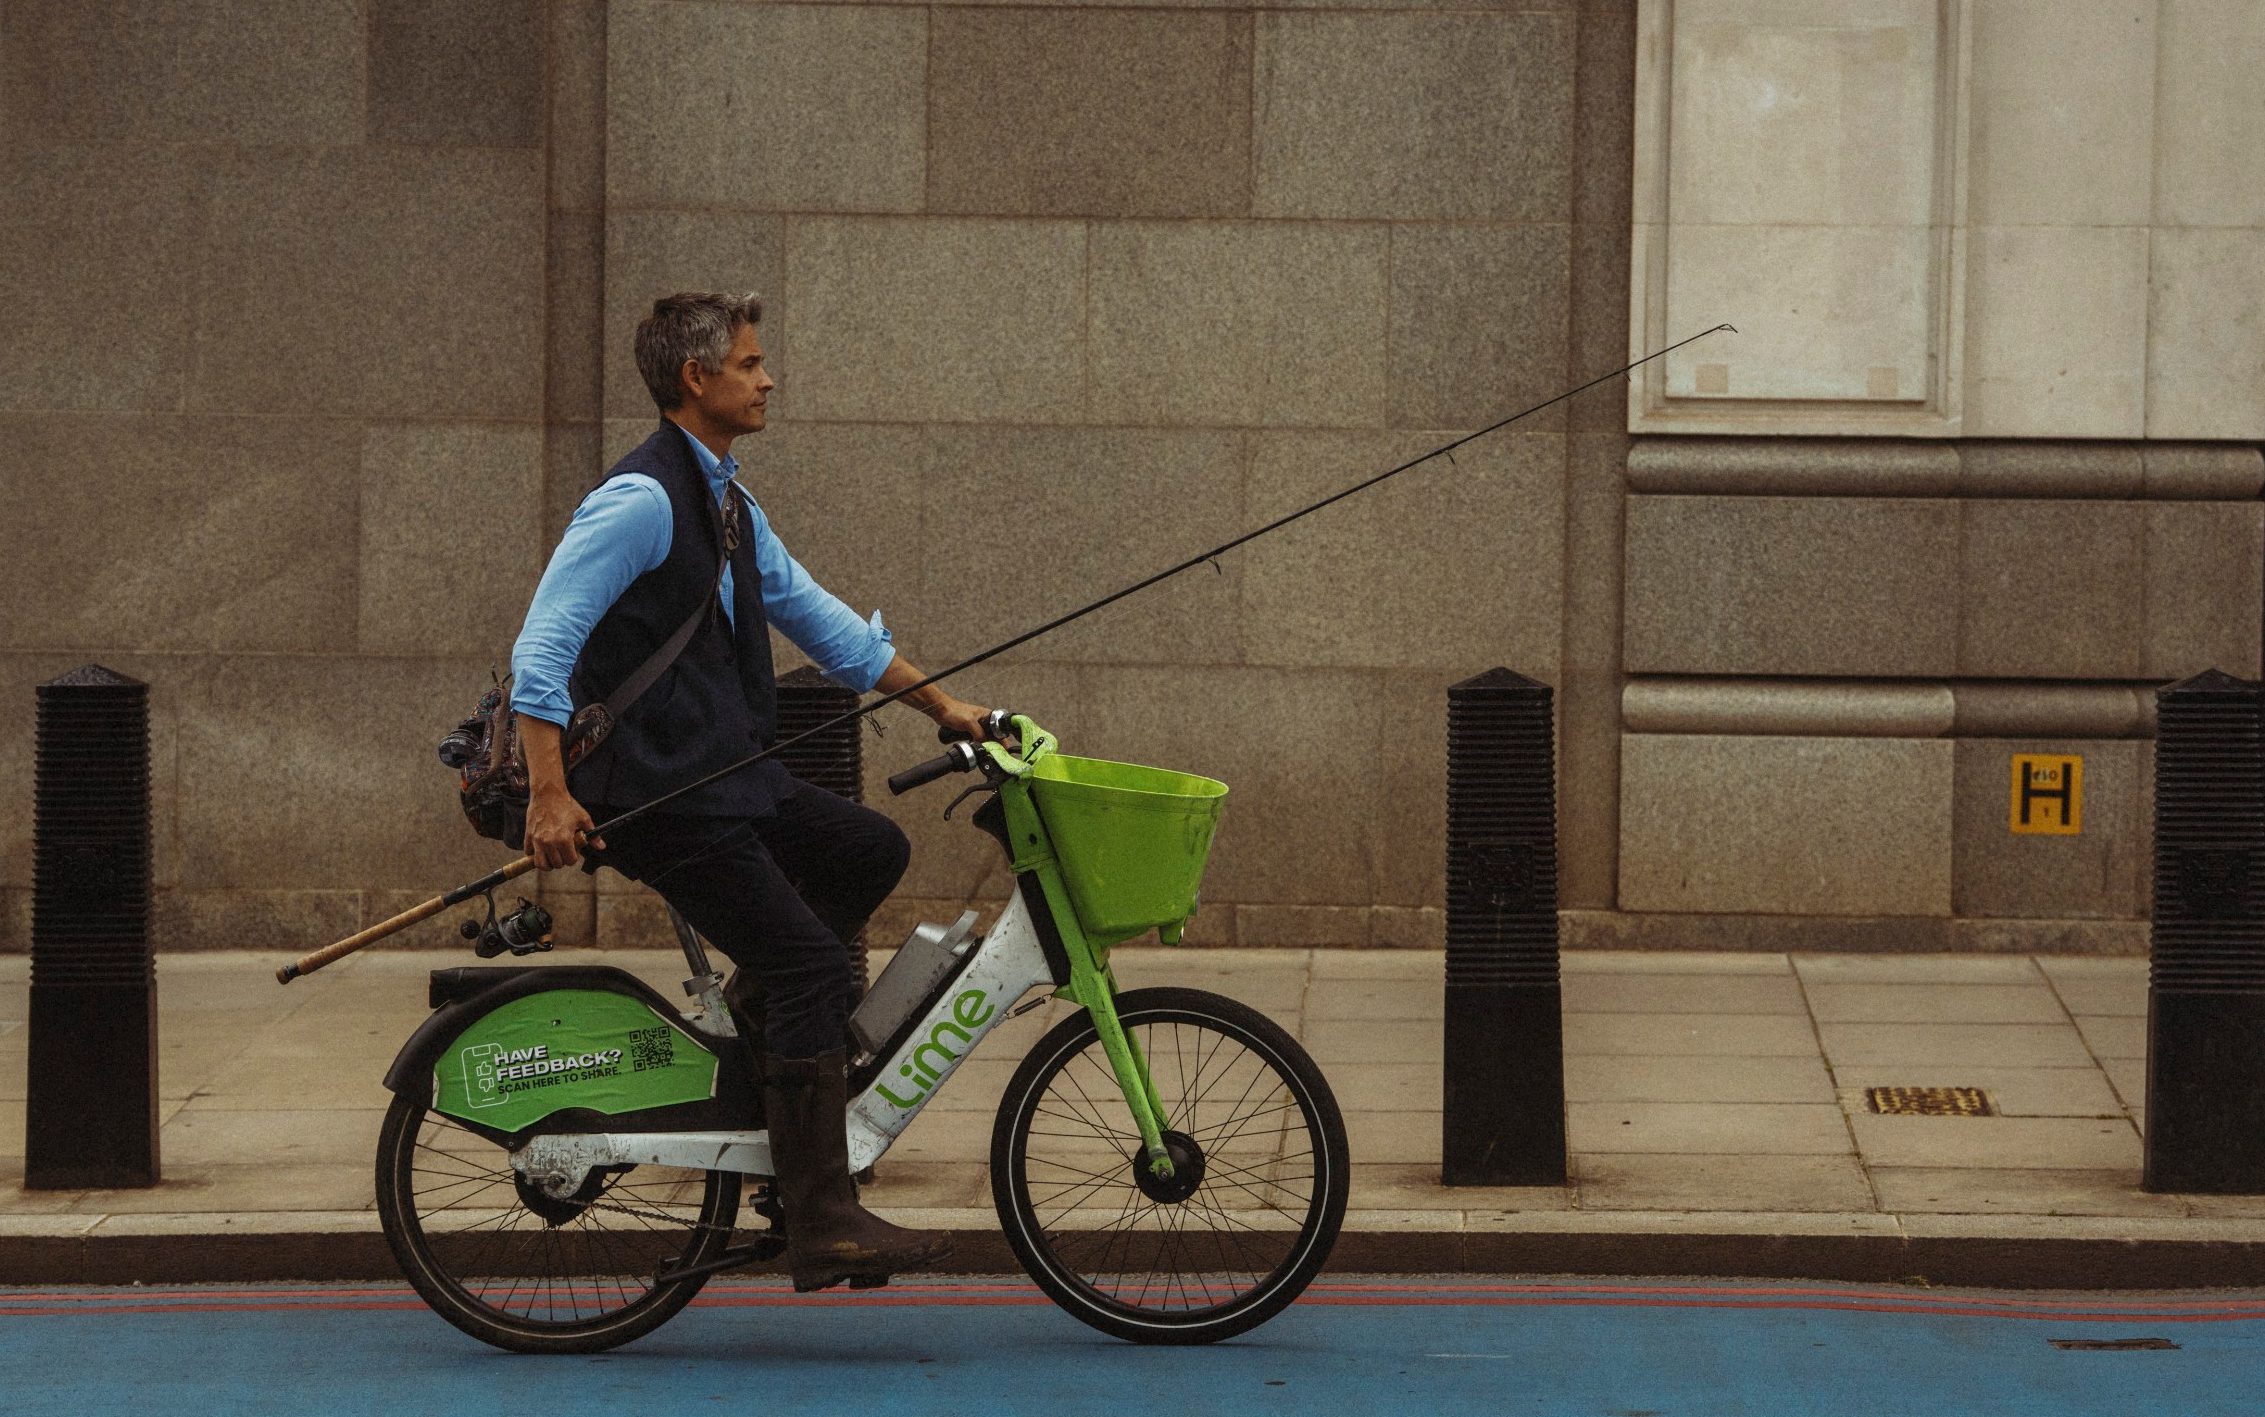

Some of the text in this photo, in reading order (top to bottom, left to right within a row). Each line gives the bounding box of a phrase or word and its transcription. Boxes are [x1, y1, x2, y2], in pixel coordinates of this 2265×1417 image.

[2021, 762, 2072, 826] H
[494, 1045, 548, 1066] HAVE
[875, 989, 995, 1108] Lime
[496, 1049, 623, 1083] FEEDBACK?
[498, 1066, 622, 1094] SCAN HERE TO SHARE.
